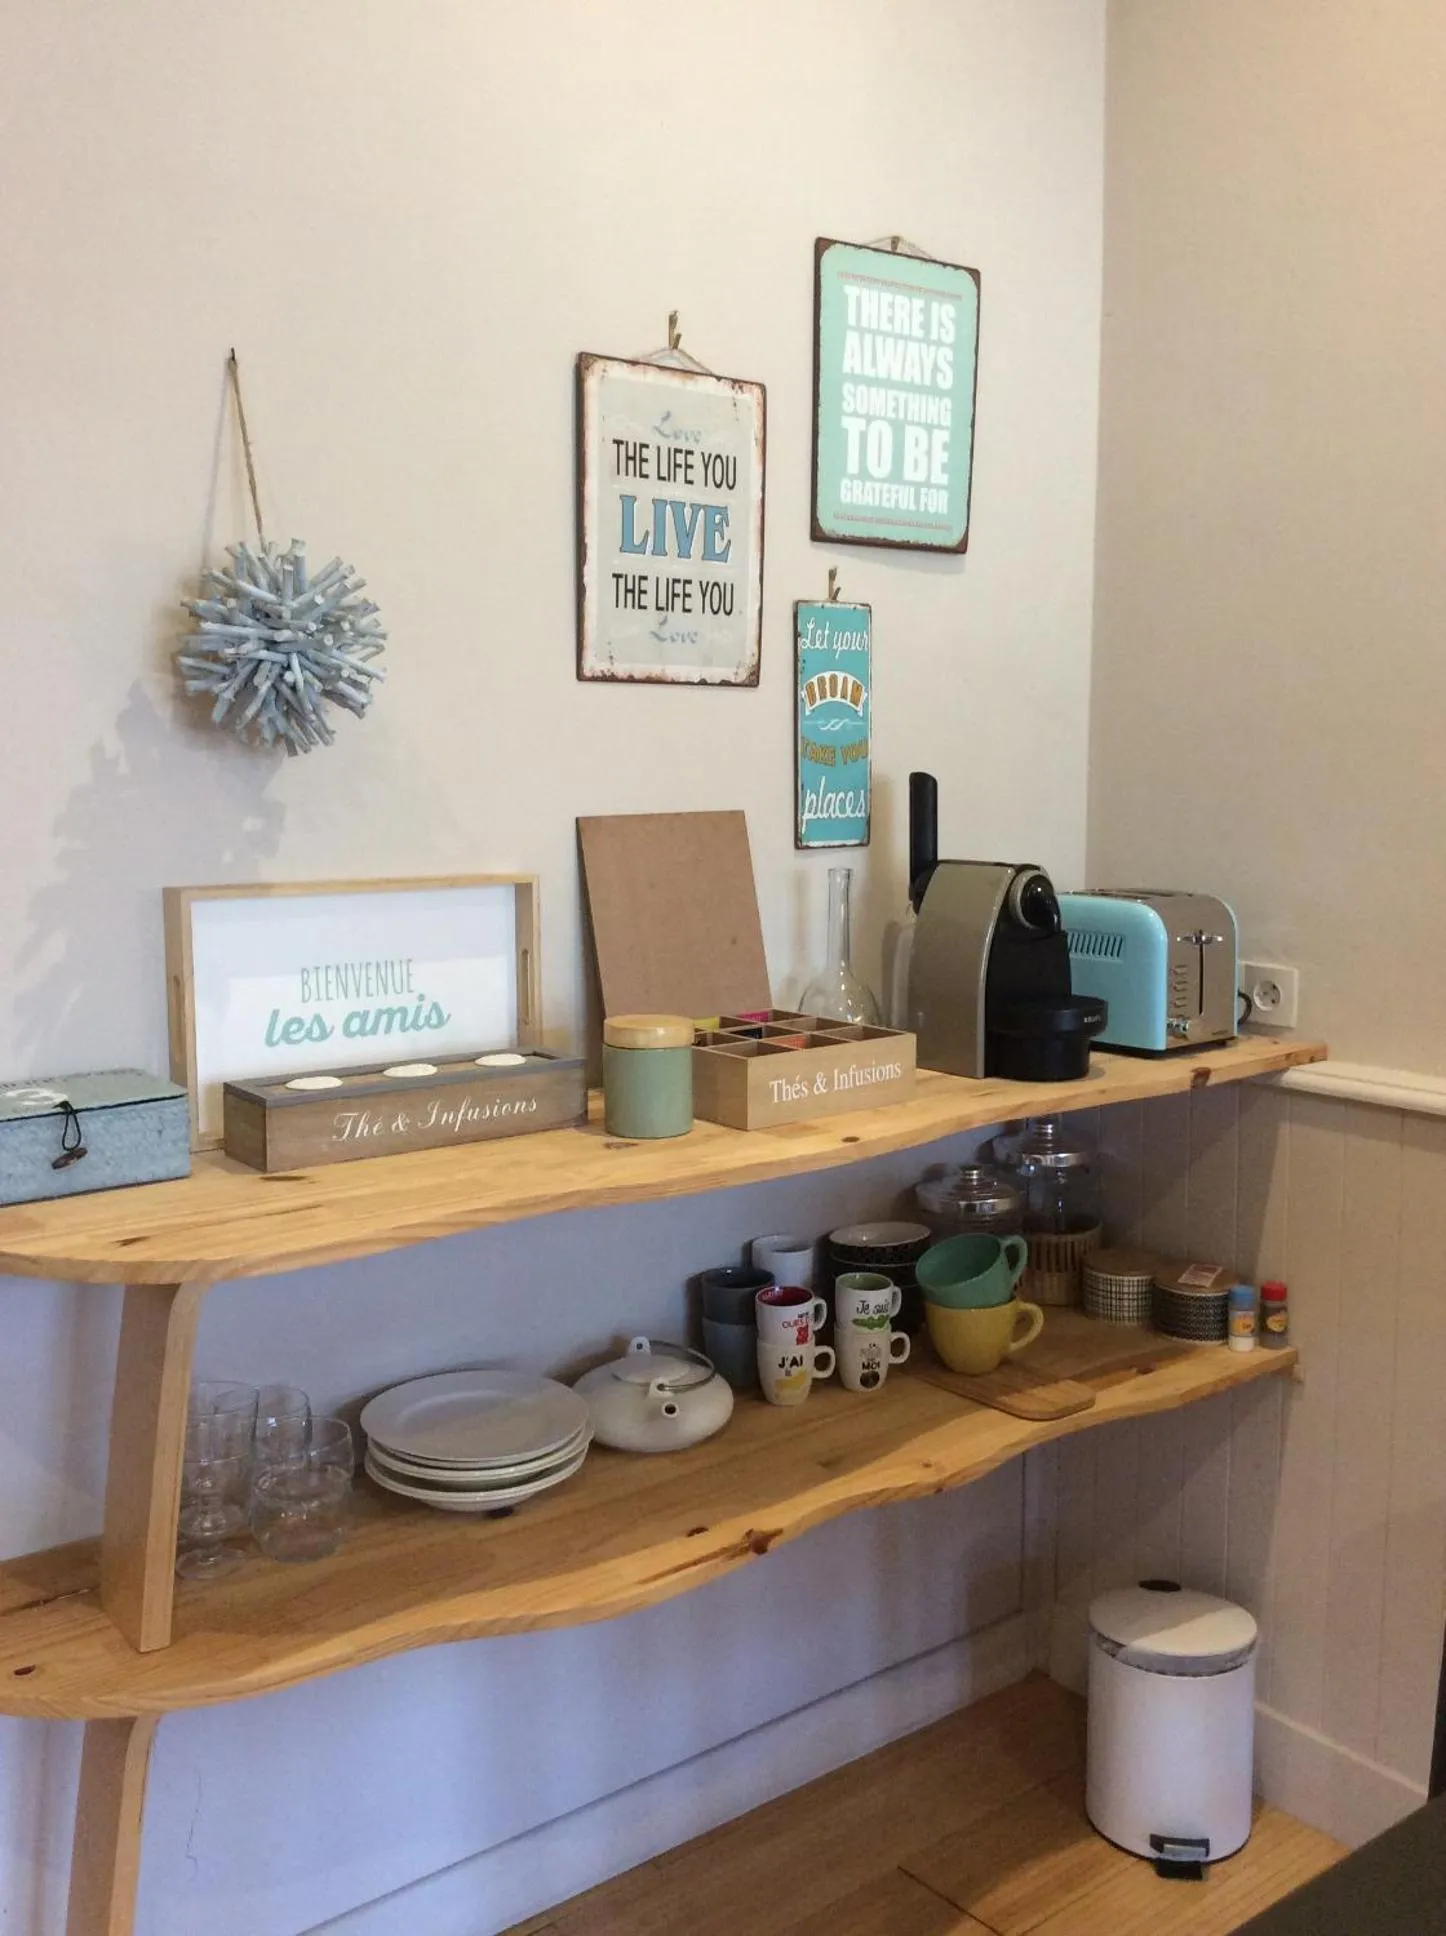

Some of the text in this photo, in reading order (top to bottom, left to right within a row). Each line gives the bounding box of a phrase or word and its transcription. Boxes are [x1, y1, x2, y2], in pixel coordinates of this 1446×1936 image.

[843, 284, 956, 345] THERE IS
[842, 329, 954, 390] ALWAYS
[652, 411, 702, 443] Love
[841, 381, 952, 428] SOMETHING
[613, 439, 737, 491] THE LIFE YOU
[841, 415, 950, 486] TO BE
[840, 477, 949, 515] GRATEFUL FOR
[619, 494, 732, 563] LIVE
[612, 573, 734, 617] THE LIFE YOU
[650, 615, 698, 644] Love
[801, 617, 869, 660] Let your
[802, 776, 867, 834] places
[300, 958, 415, 1004] BIENVENUE
[264, 993, 452, 1048] les amis
[768, 1059, 902, 1103] Thés & Infusions
[391, 1111, 410, 1133] &
[417, 1096, 538, 1132] Infusions
